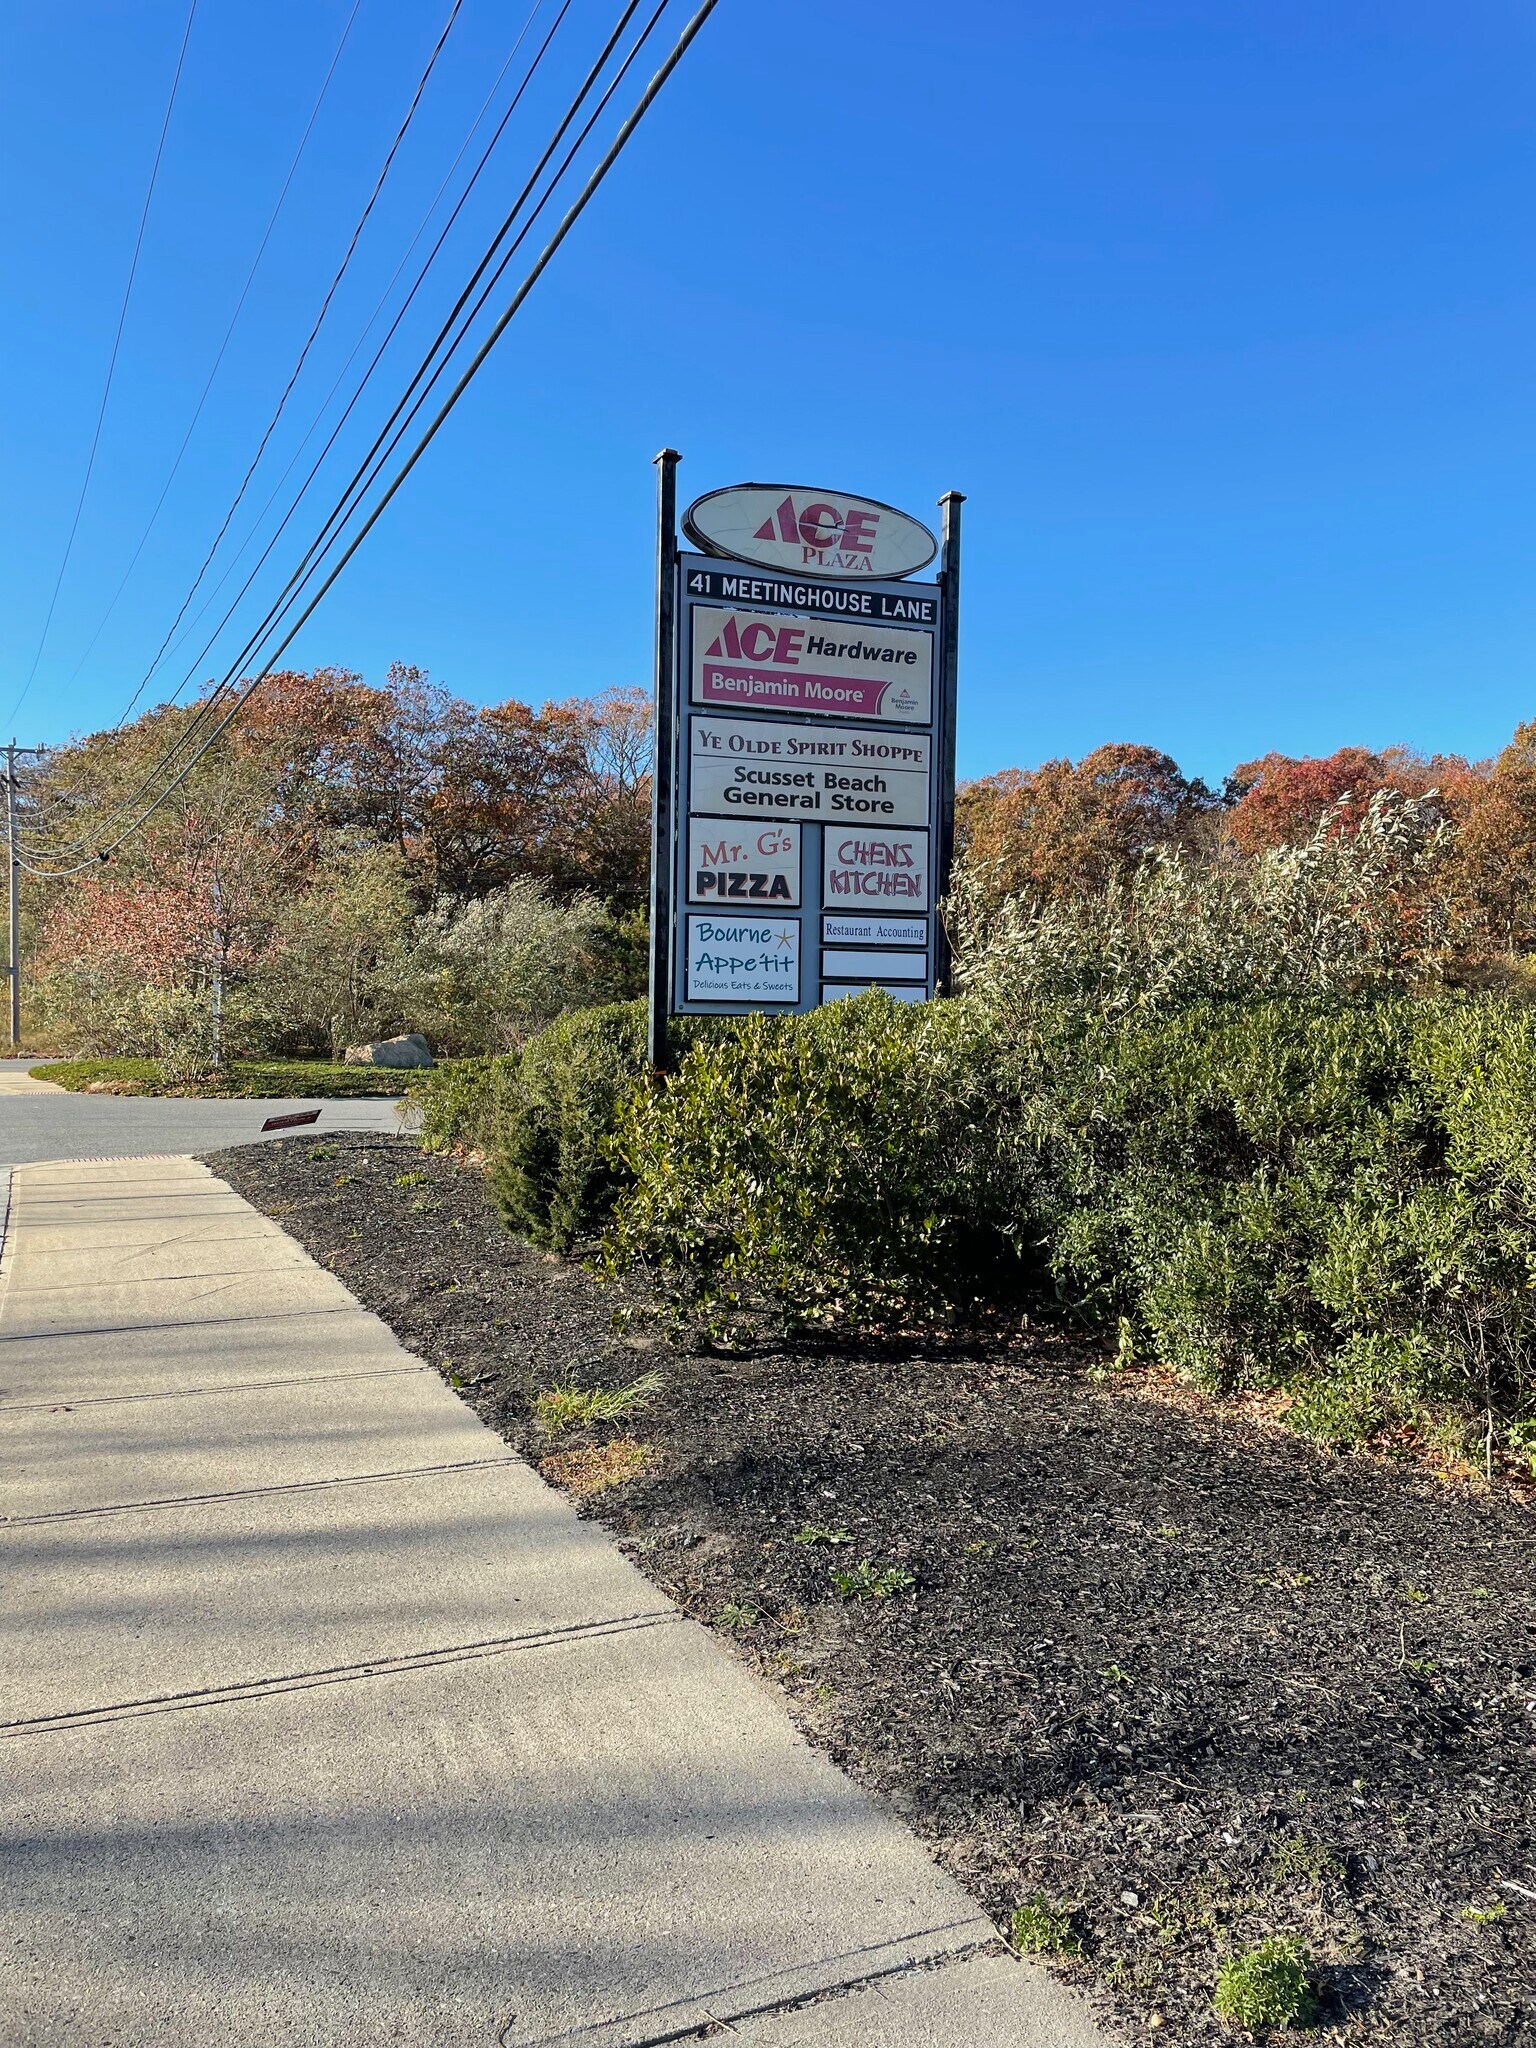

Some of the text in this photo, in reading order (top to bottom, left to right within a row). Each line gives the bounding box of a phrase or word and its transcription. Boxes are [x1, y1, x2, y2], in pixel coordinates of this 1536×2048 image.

[753, 495, 880, 552] ACE
[802, 548, 873, 571] PLAZA
[690, 574, 931, 620] 41 MEETINGHOUSE LANE
[704, 616, 917, 664] ACE Hardware
[712, 672, 862, 703] Benjamin Moore
[698, 730, 923, 762] YE OLDE SPIRIT SHOPPE
[734, 766, 886, 792] Scusset Beach
[724, 787, 894, 813] General Store
[701, 829, 791, 867] Mr. G's
[696, 871, 792, 900] PIZZA
[830, 870, 922, 897] KITCHEN
[696, 923, 771, 943] Bourne
[826, 923, 924, 940] Restaurant Accounting
[693, 980, 793, 991] Delicious Eats & Sweets
